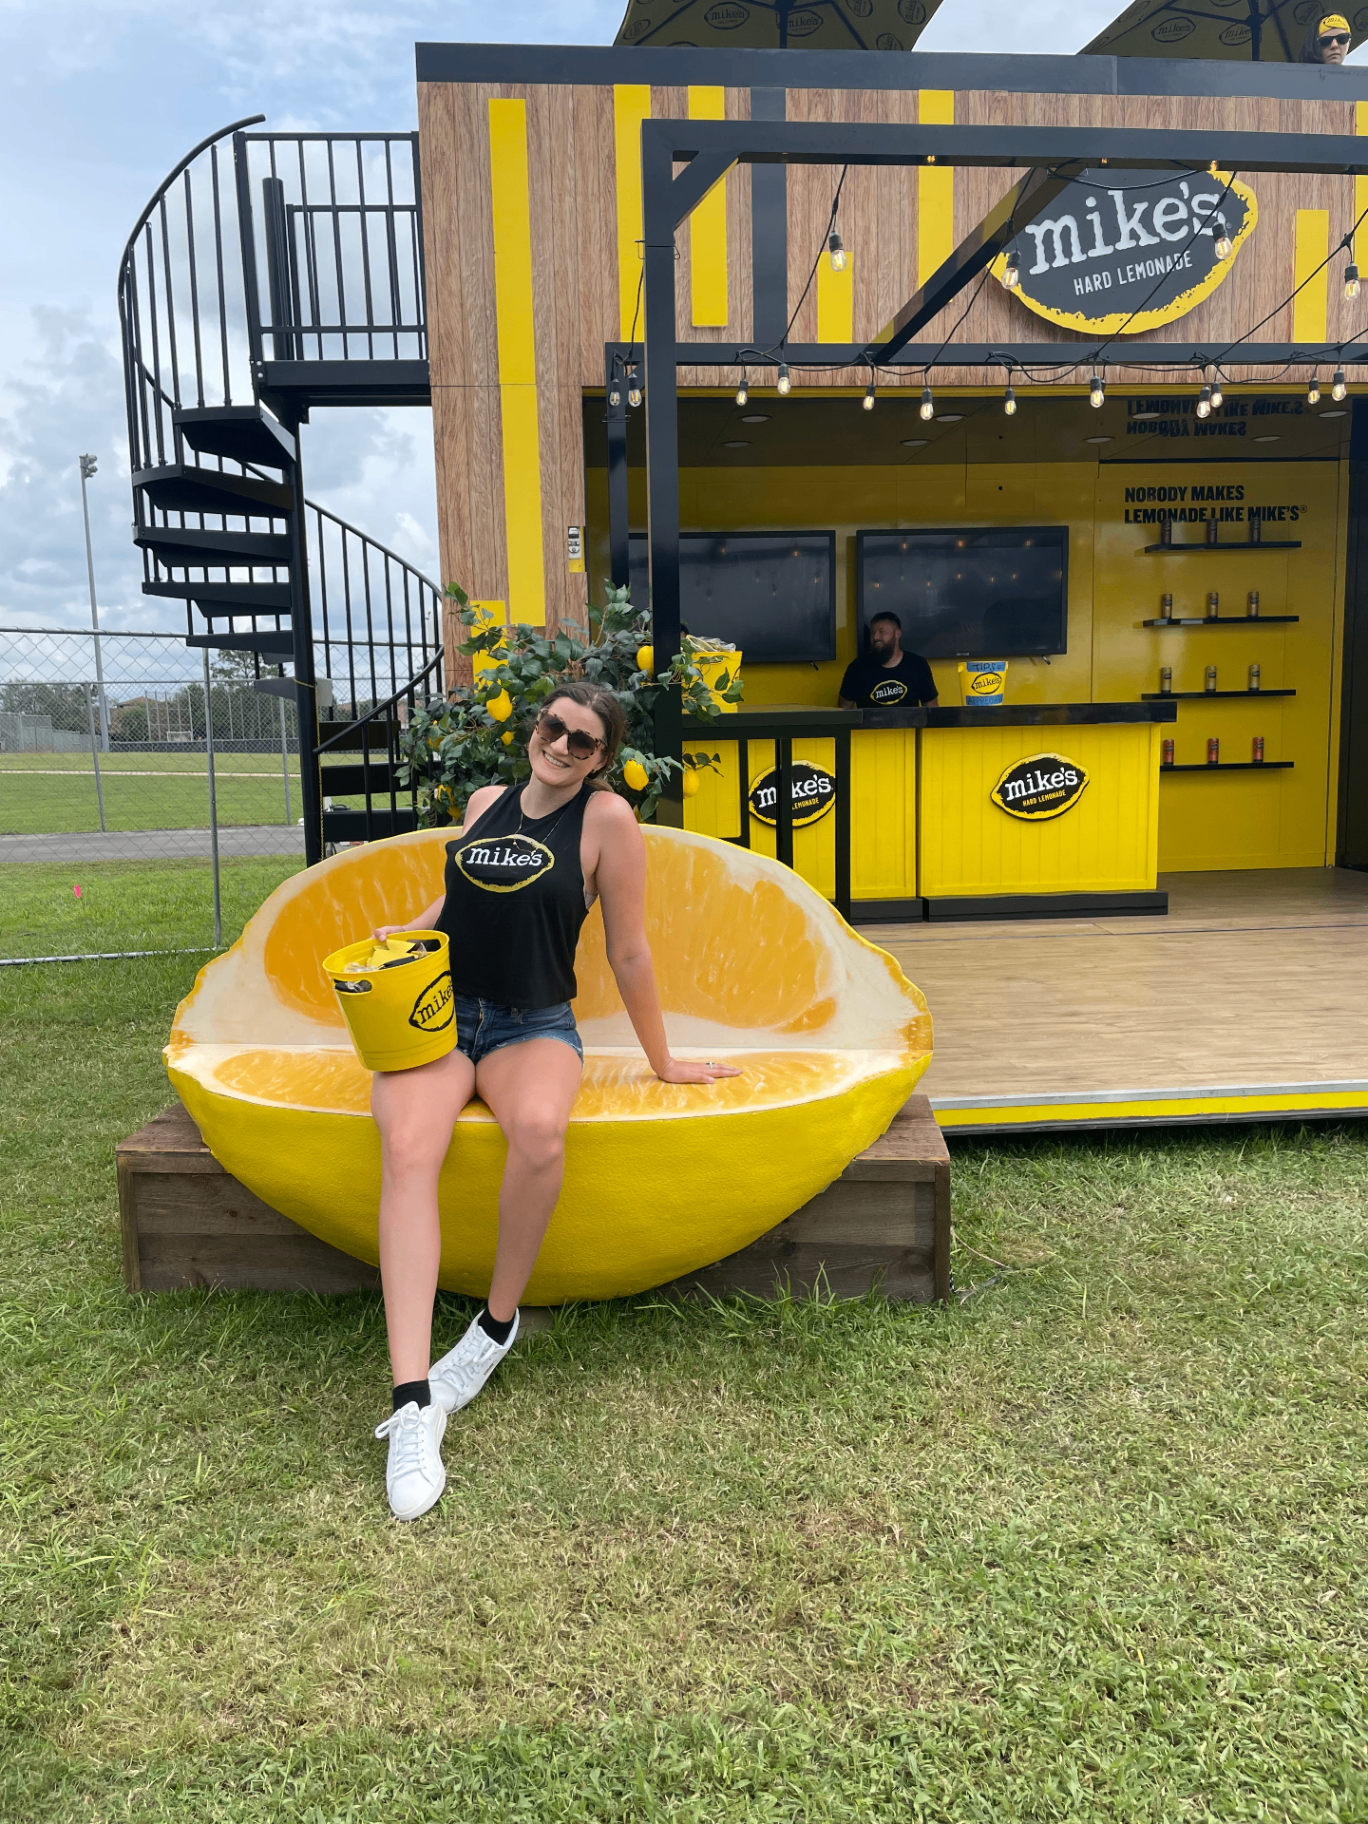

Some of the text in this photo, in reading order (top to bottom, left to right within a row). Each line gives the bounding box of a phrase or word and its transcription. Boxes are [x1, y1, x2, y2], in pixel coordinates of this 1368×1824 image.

[1025, 181, 1227, 275] mike's
[1073, 250, 1193, 296] HARD LEMONADE
[1125, 485, 1244, 503] NOBODY MAKES
[1125, 507, 1206, 524] LEMONADE
[1210, 506, 1243, 522] LIKE
[972, 662, 996, 672] TIPS
[875, 686, 904, 699] mike's
[757, 774, 832, 809] mke's
[1004, 767, 1078, 801] mike's
[1022, 789, 1066, 807] HARD LEMONADE
[466, 847, 543, 867] mike's
